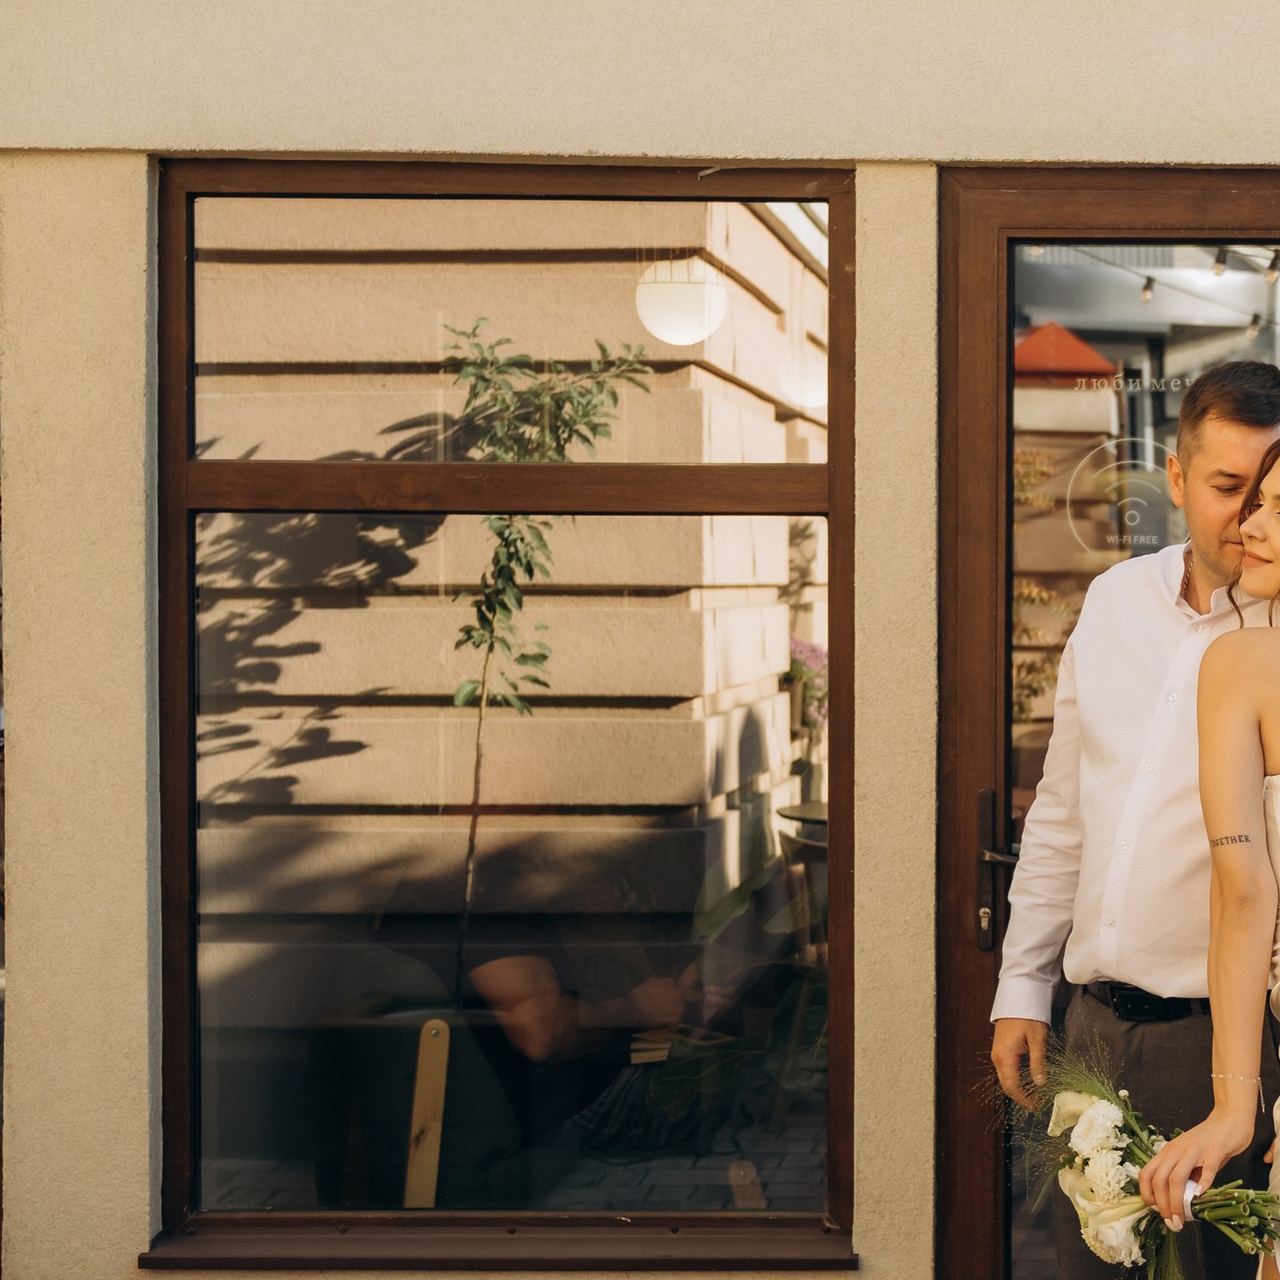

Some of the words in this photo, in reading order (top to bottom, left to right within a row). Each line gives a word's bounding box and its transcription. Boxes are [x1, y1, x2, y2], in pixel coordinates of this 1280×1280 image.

[1075, 372, 1142, 391] люби
[1151, 377, 1196, 391] меч
[1107, 535, 1131, 544] WI-FI
[1133, 535, 1158, 544] FREE
